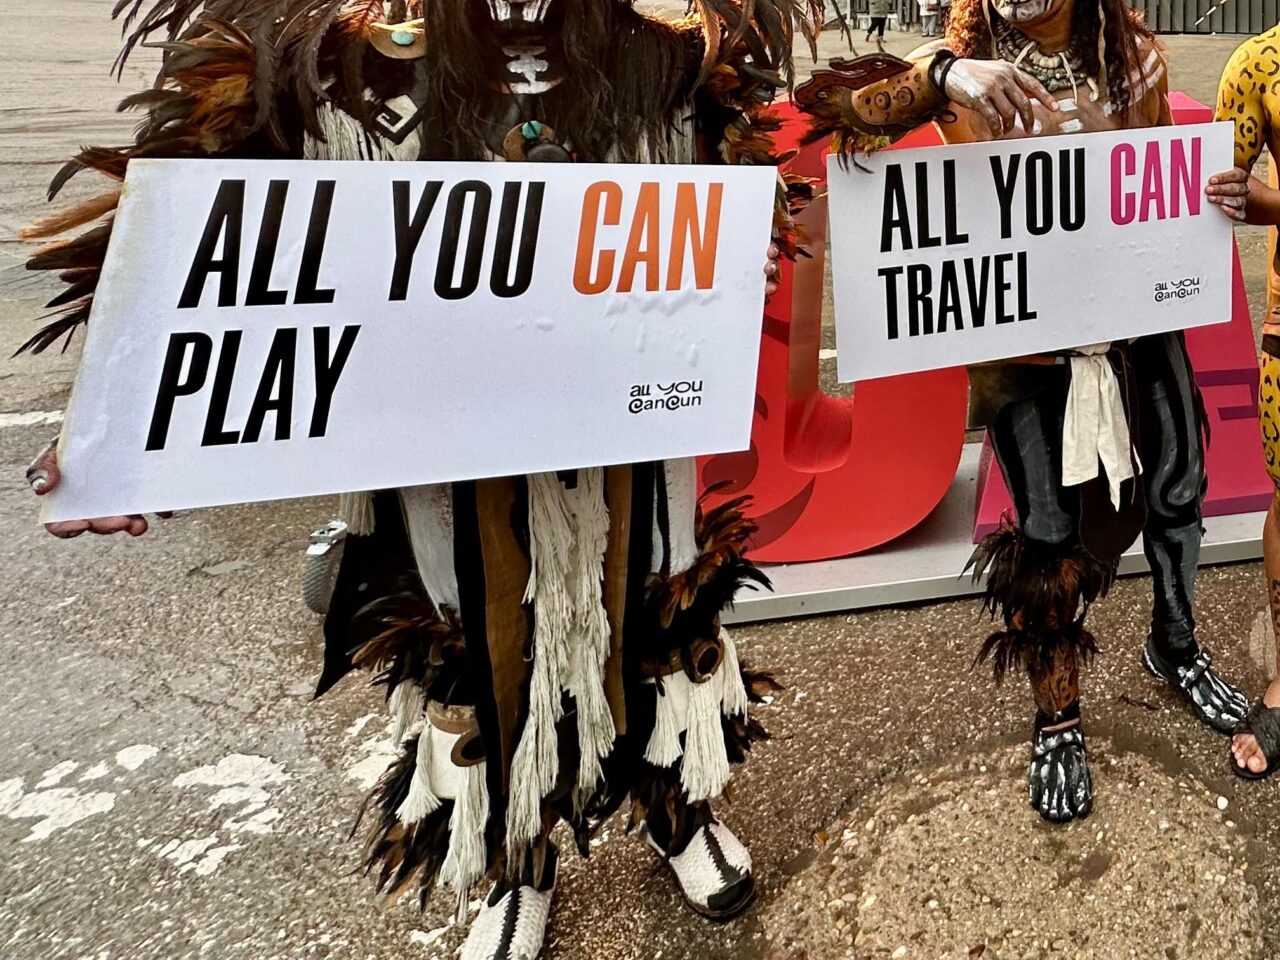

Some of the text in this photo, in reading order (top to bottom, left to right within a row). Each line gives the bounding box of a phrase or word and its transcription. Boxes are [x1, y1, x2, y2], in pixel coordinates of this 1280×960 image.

[177, 180, 722, 308] ALL YOU CAN
[881, 138, 1201, 252] ALL YOU CAN
[878, 251, 1037, 339] TRAVEL
[145, 325, 361, 451] PLAY
